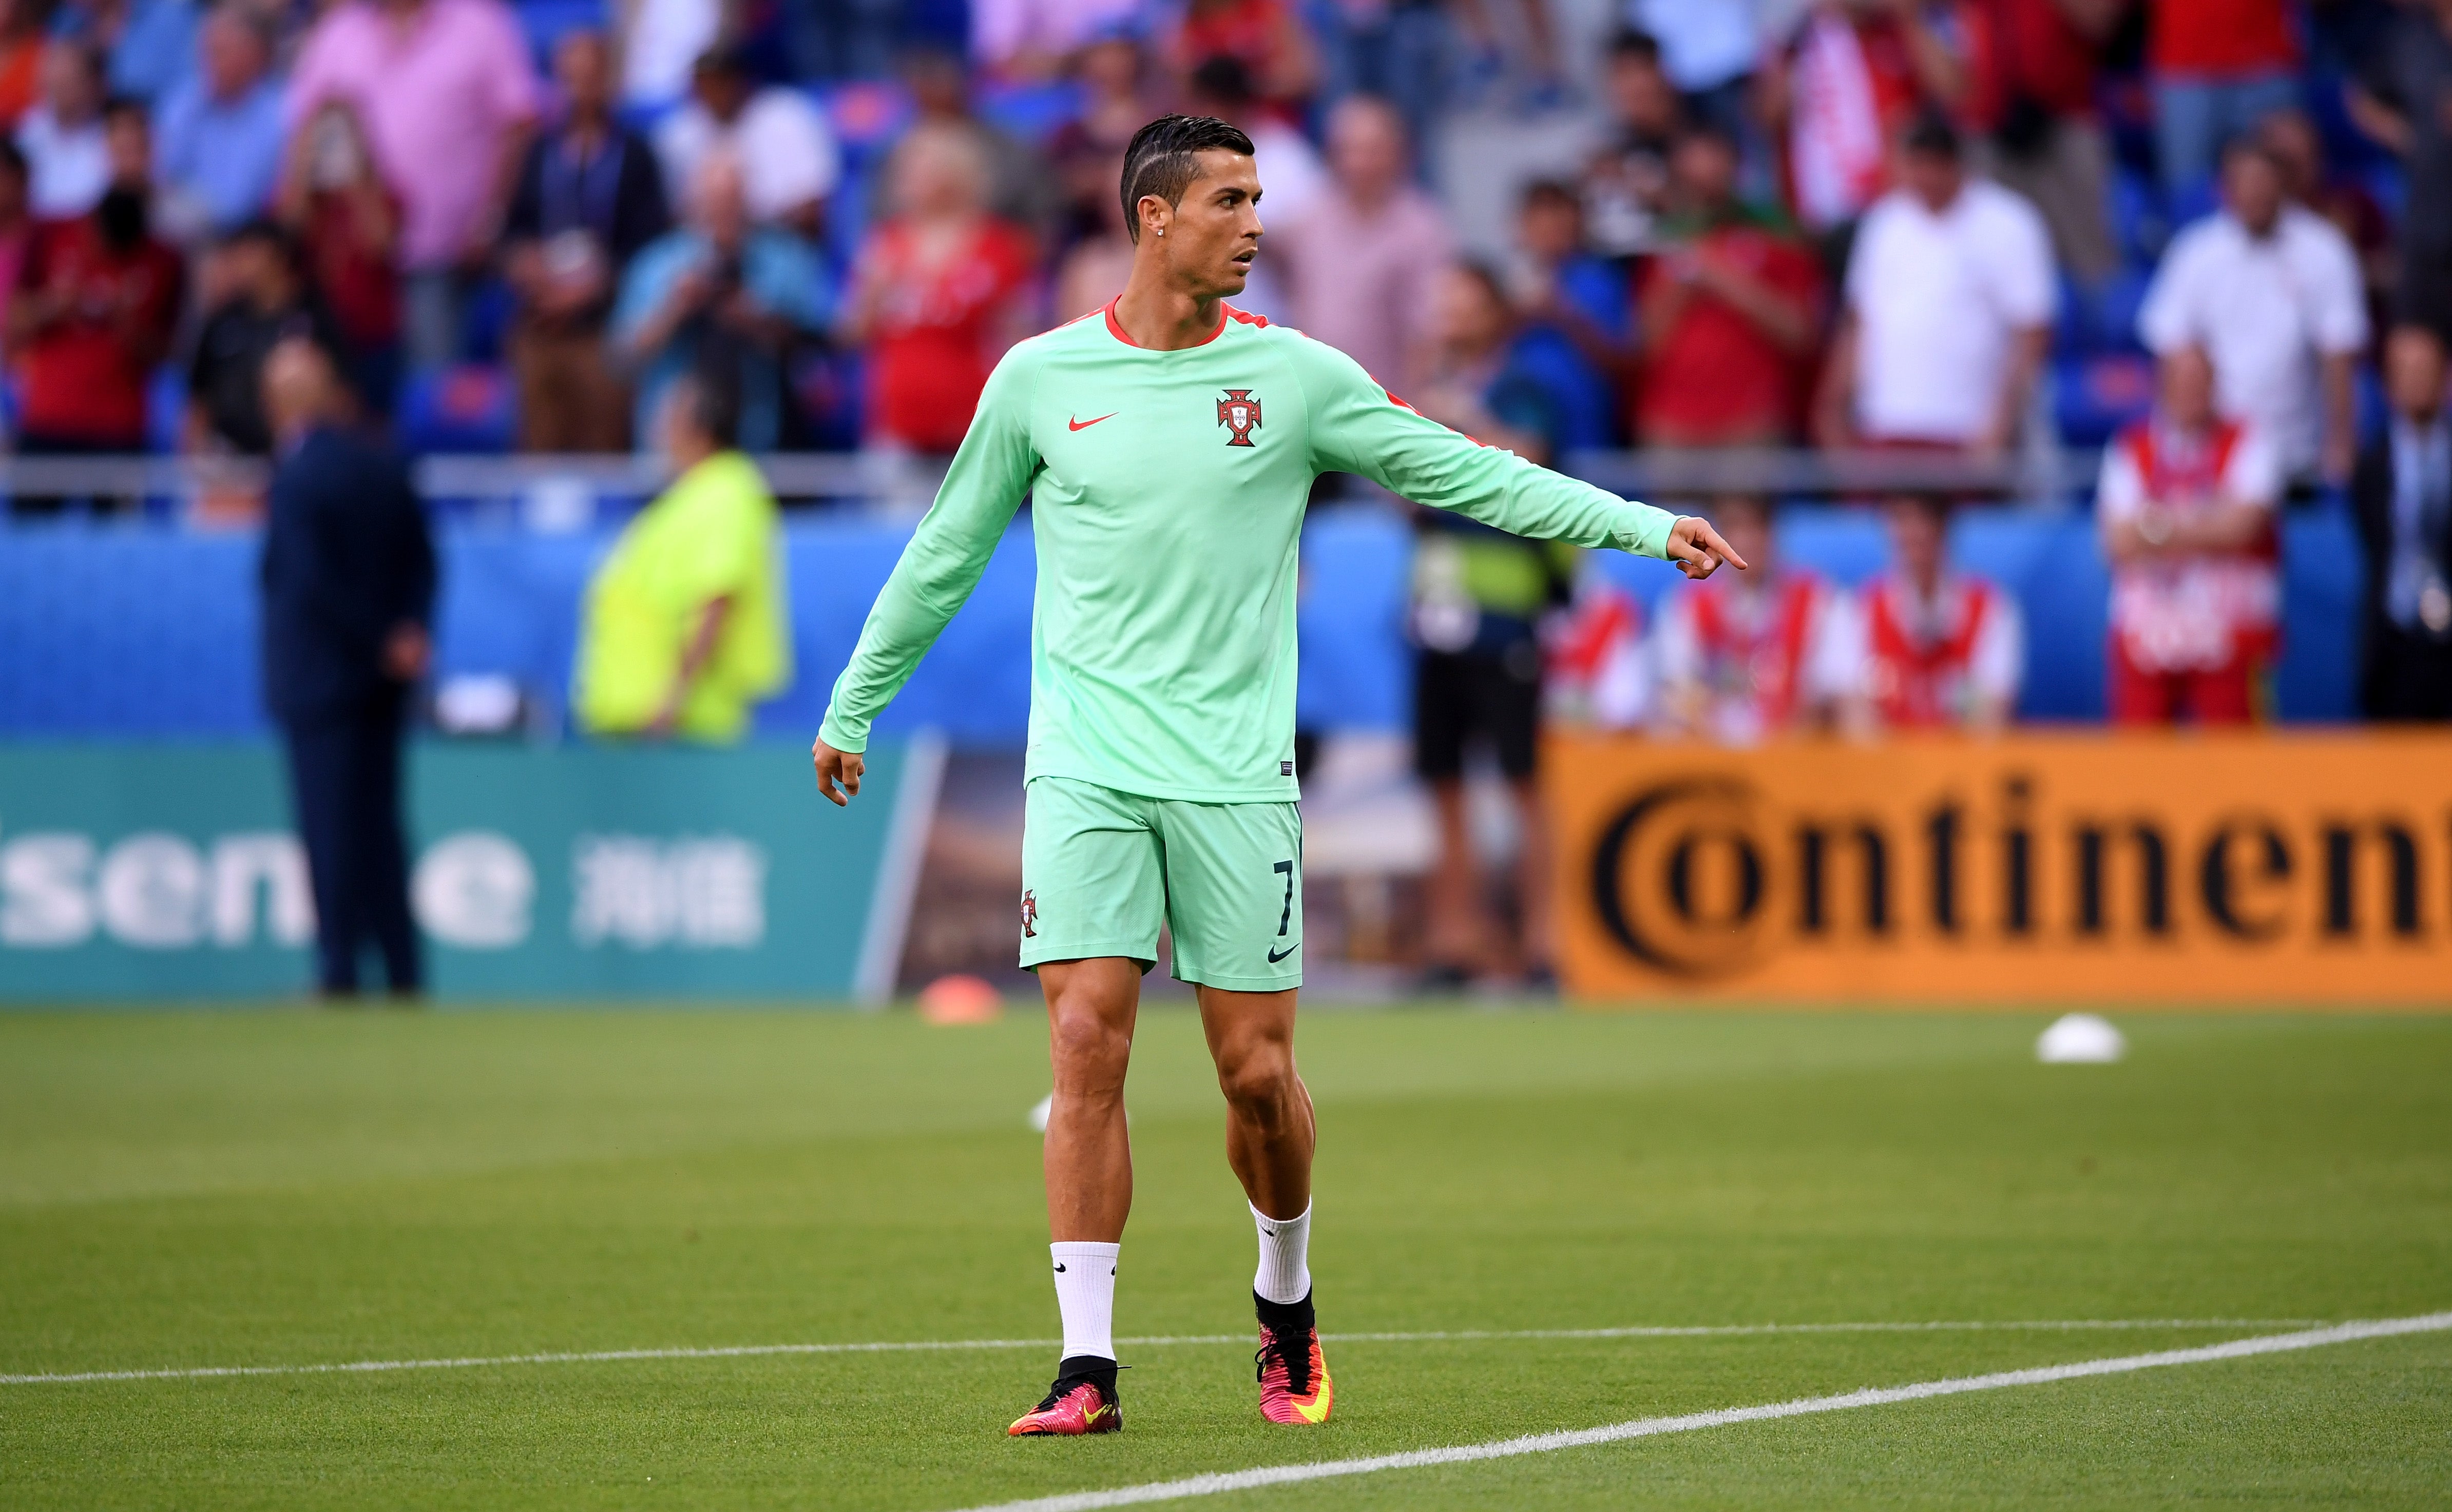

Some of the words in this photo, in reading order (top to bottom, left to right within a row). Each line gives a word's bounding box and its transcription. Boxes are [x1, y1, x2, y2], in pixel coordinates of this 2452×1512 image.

[0, 831, 535, 946] sene
[1273, 860, 1293, 936] 7
[1587, 774, 2452, 981] Continen
